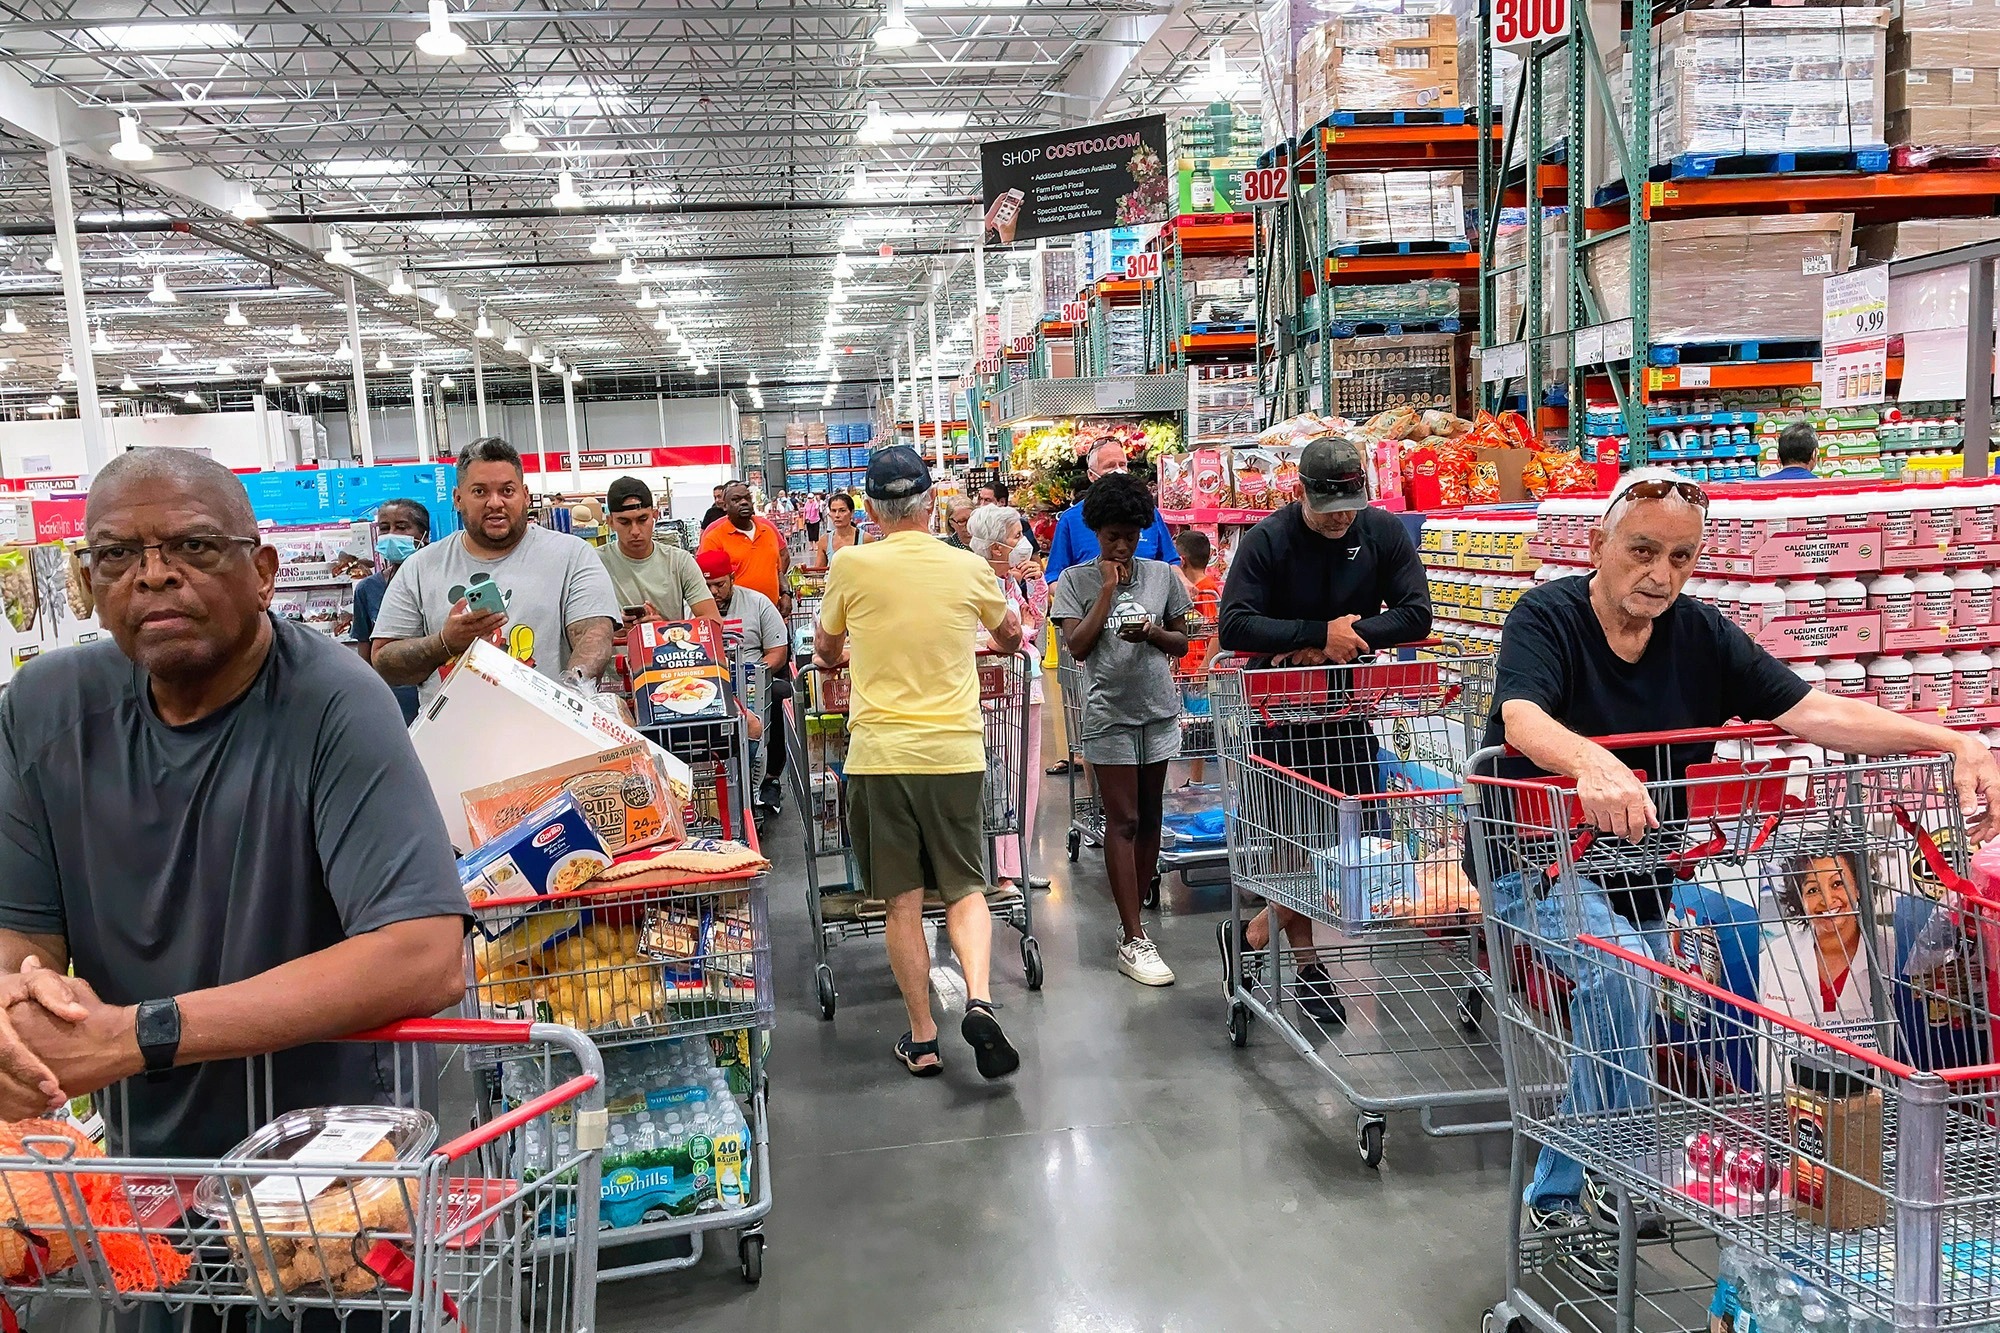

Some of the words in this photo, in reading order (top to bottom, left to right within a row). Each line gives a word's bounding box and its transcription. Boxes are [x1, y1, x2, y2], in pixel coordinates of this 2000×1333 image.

[1496, 0, 1565, 43] 300
[1002, 148, 1041, 167] SHOP
[1045, 131, 1141, 160] COSTCO.COM
[1035, 170, 1064, 181] Additional
[1064, 166, 1090, 177] Selection
[1091, 163, 1117, 173] Available
[1036, 185, 1051, 194] Farm
[1051, 184, 1067, 192] Fresh
[1068, 181, 1084, 190] Floral
[1245, 168, 1288, 202] 302
[1037, 192, 1063, 203] Delivered
[1071, 190, 1084, 198] Your
[1085, 187, 1100, 196] Door
[1037, 206, 1058, 217] Special
[1058, 203, 1090, 213] Occasions,
[1038, 213, 1067, 224] Weddings,
[1068, 212, 1081, 220] Bulk
[1087, 209, 1102, 217] More
[1127, 253, 1159, 278] 304
[1062, 303, 1087, 322] 306
[1856, 311, 1884, 334] 9.99
[1014, 336, 1035, 353] 308
[981, 360, 999, 373] 310
[960, 376, 974, 389] 312
[563, 455, 605, 464] KKLAND
[613, 453, 643, 466] DELI
[27, 481, 74, 491] KIRKLAND
[316, 472, 330, 510] UNREAL
[435, 466, 447, 504] UNREAL
[1784, 543, 1818, 552] CALCIUM
[1818, 541, 1850, 550] CITRATE
[1794, 549, 1839, 558] MAGNESIUM
[699, 620, 705, 628] 2
[1783, 627, 1817, 636] CALCIUM
[1817, 625, 1849, 633] CITRATE
[1793, 632, 1838, 641] MAGNESIUM
[656, 651, 703, 664] QUAKER
[668, 659, 696, 668] OATS
[674, 670, 705, 678] FASHIONED
[582, 798, 616, 816] CUP
[633, 818, 650, 831] 24
[540, 824, 562, 843] Barilla
[629, 829, 648, 844] 2.5
[718, 1140, 737, 1155] 40
[1798, 1141, 1823, 1155] Choce
[122, 1184, 175, 1196] COSTC
[600, 1172, 669, 1198] phyrhills
